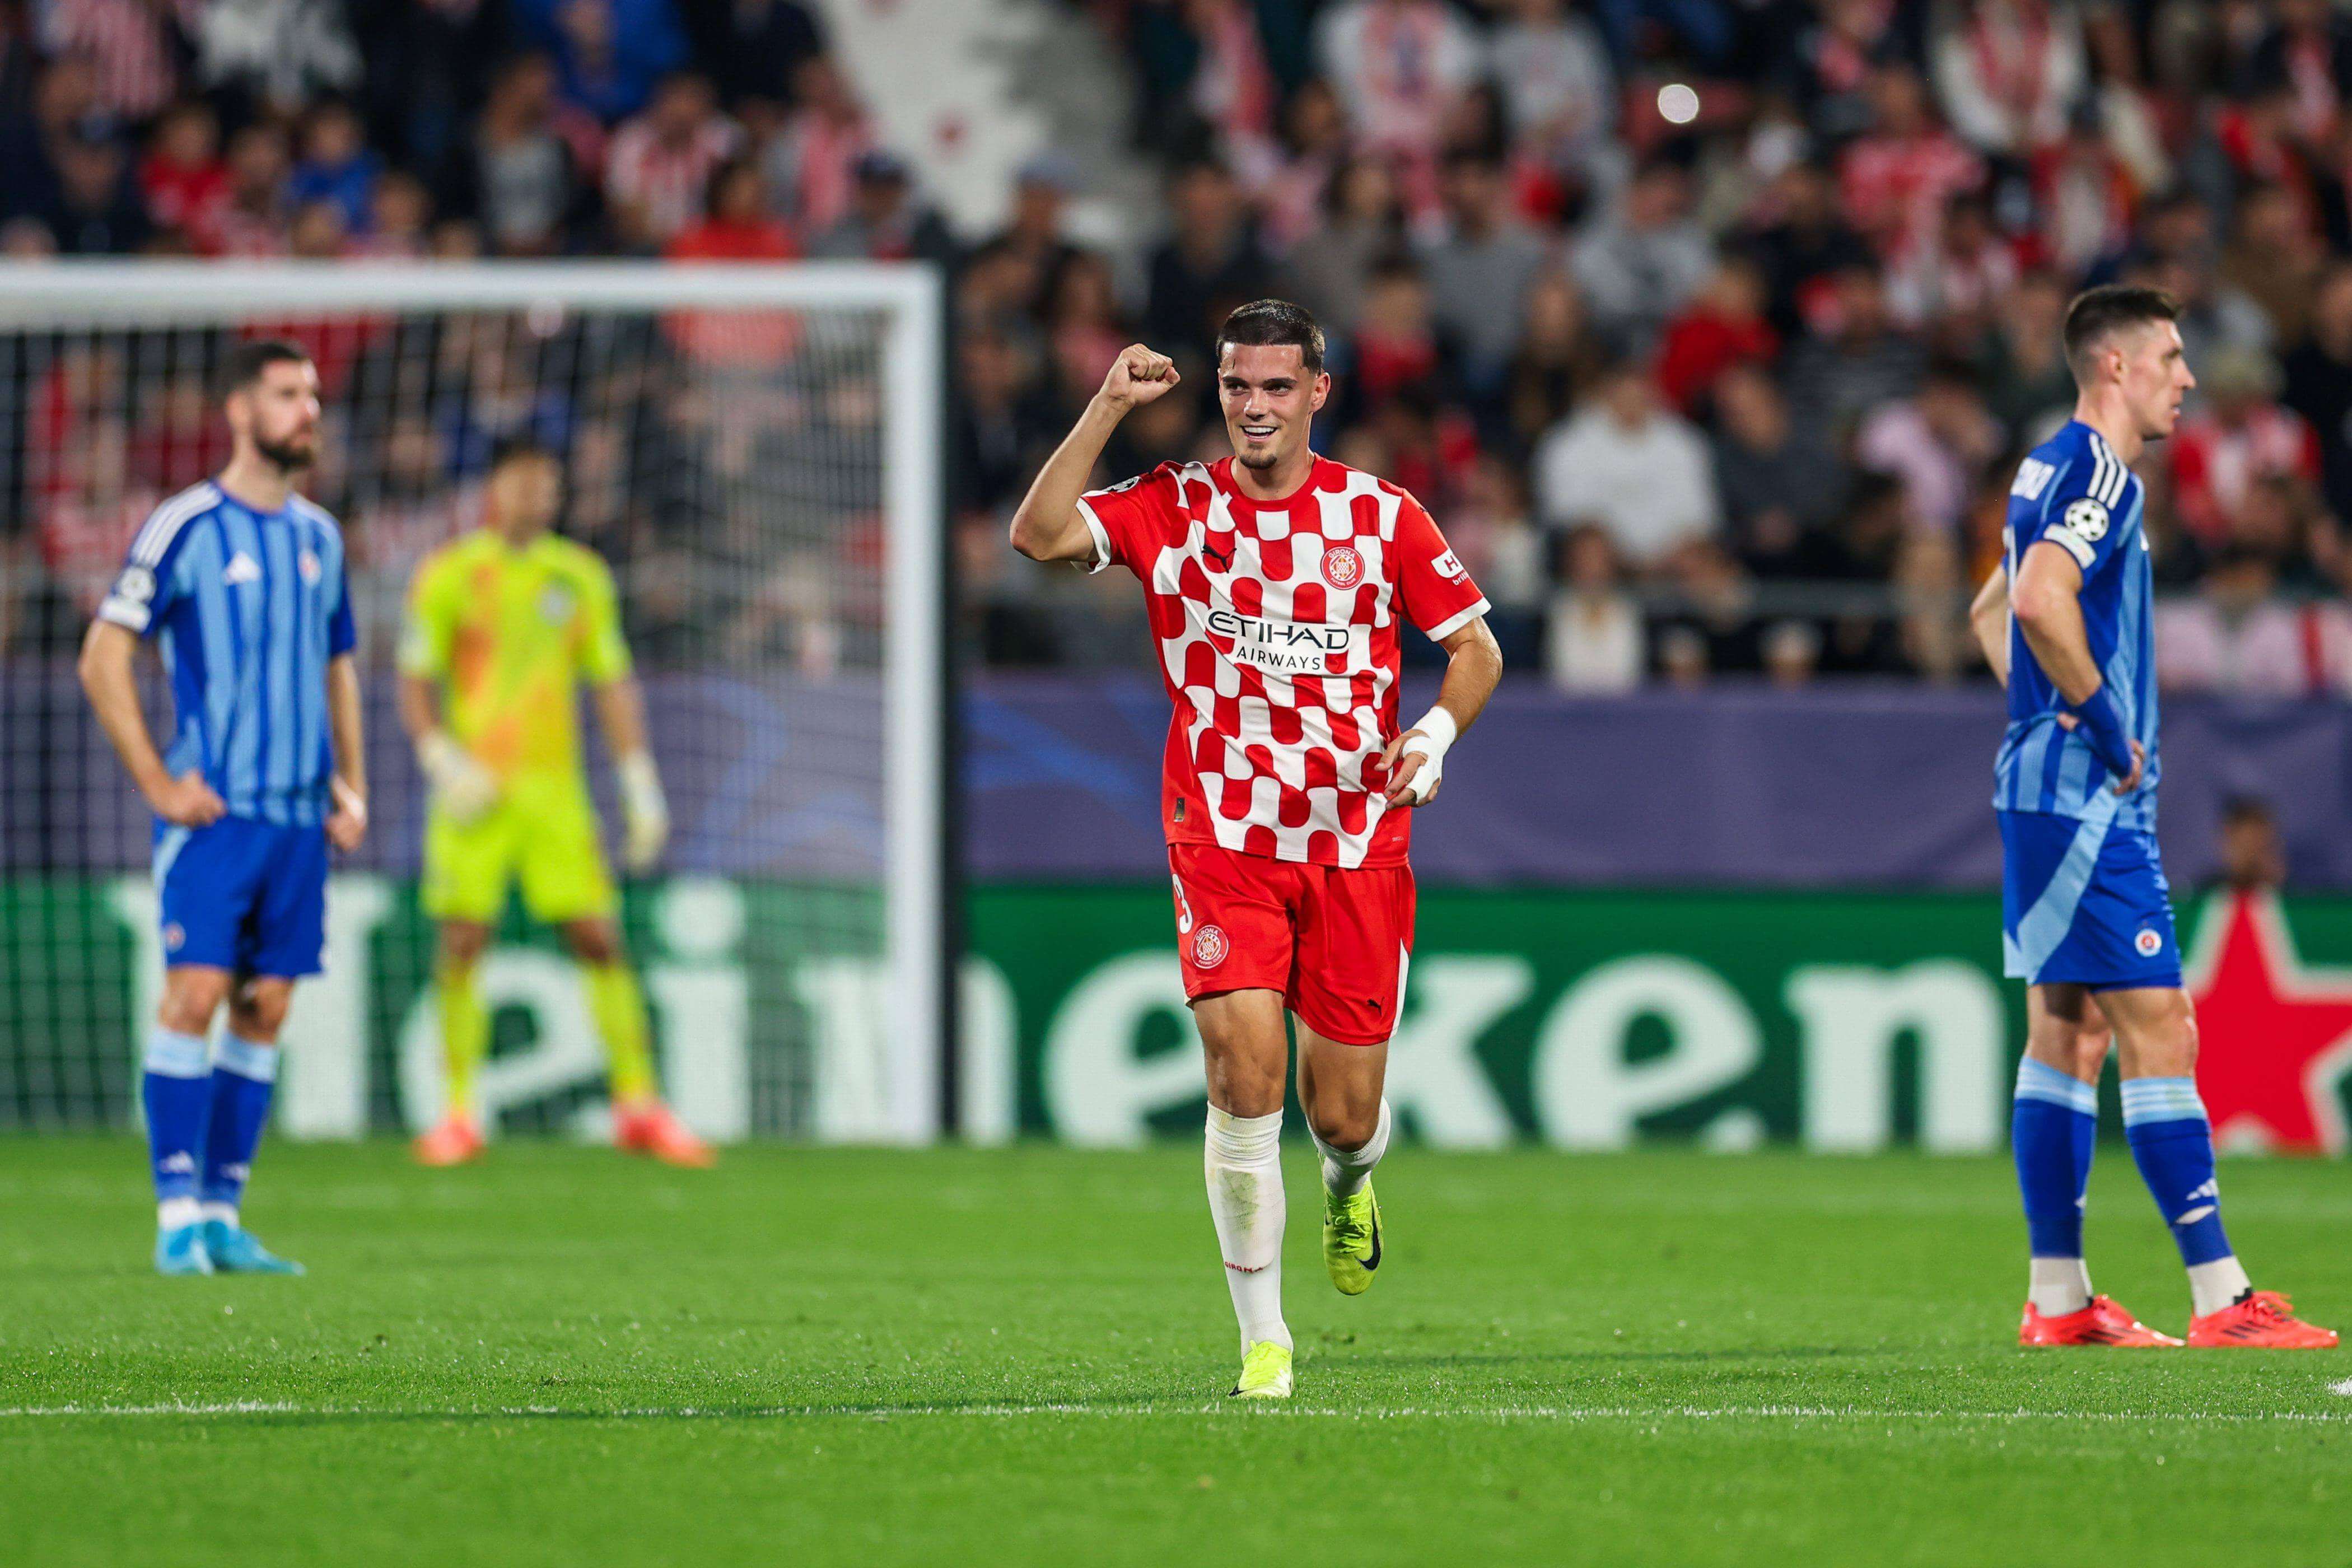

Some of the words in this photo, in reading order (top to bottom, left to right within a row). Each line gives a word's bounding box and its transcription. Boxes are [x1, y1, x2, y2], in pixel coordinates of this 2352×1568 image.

[1328, 549, 1355, 559] GIRONA
[1208, 610, 1350, 650] ETIHAD
[1236, 646, 1321, 670] AIRWAYS
[1172, 874, 1193, 934] 3
[1196, 928, 1219, 941] GIRONA
